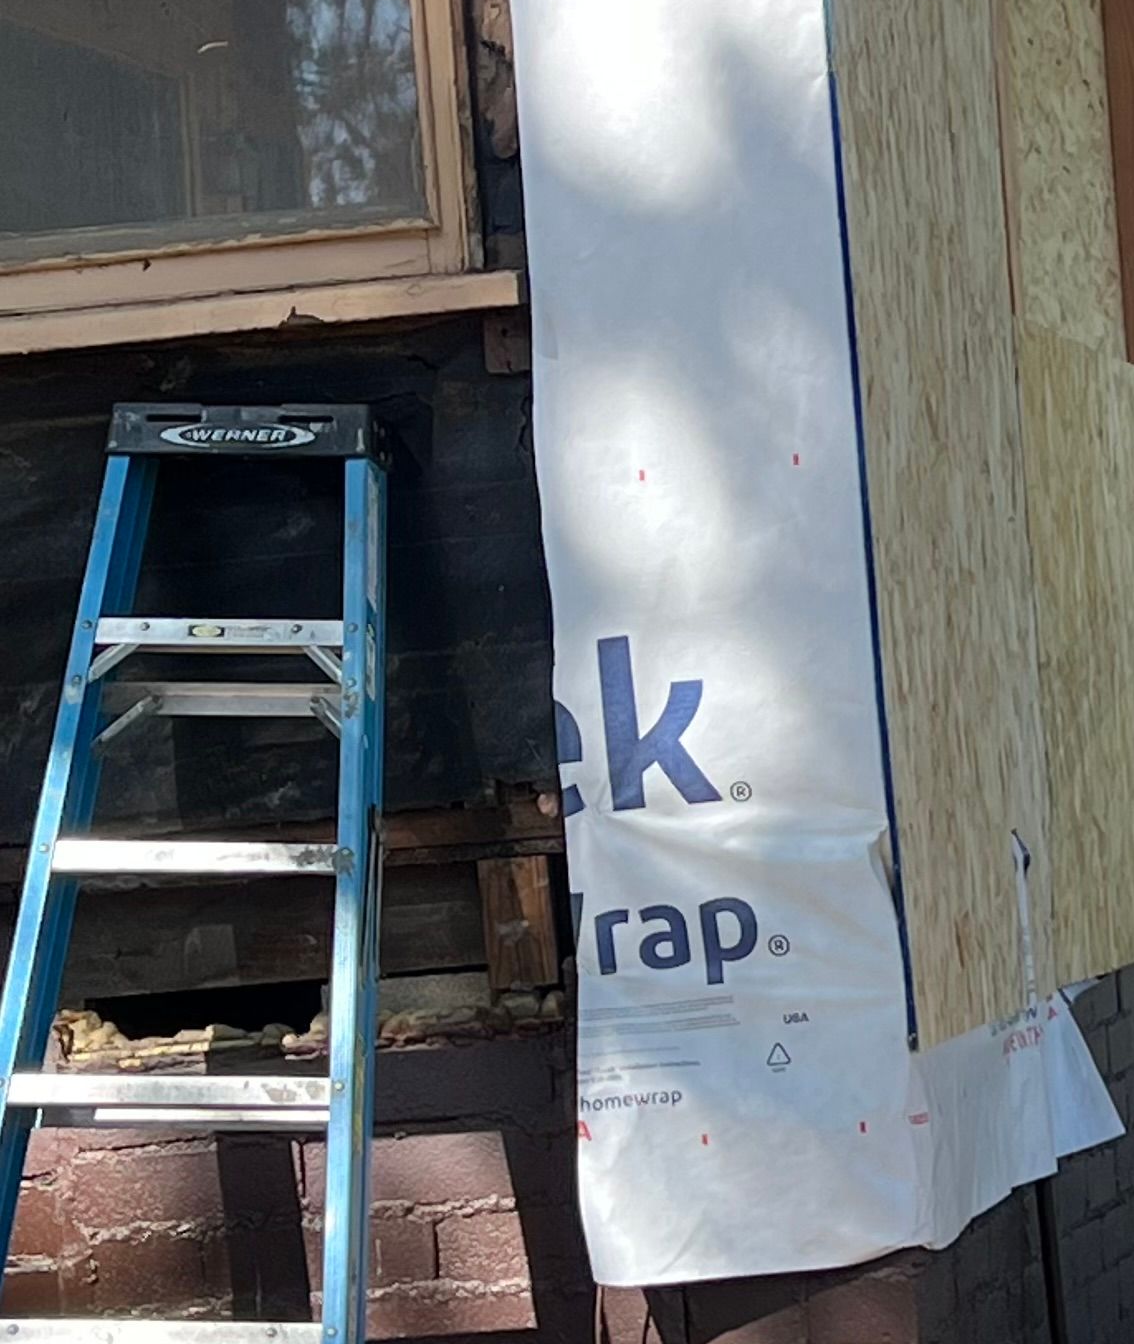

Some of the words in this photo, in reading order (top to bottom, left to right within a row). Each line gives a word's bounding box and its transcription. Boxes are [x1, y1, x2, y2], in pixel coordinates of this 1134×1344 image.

[191, 428, 286, 442] WERNER
[782, 1012, 810, 1025] USA
[579, 1088, 683, 1113] homewrap
